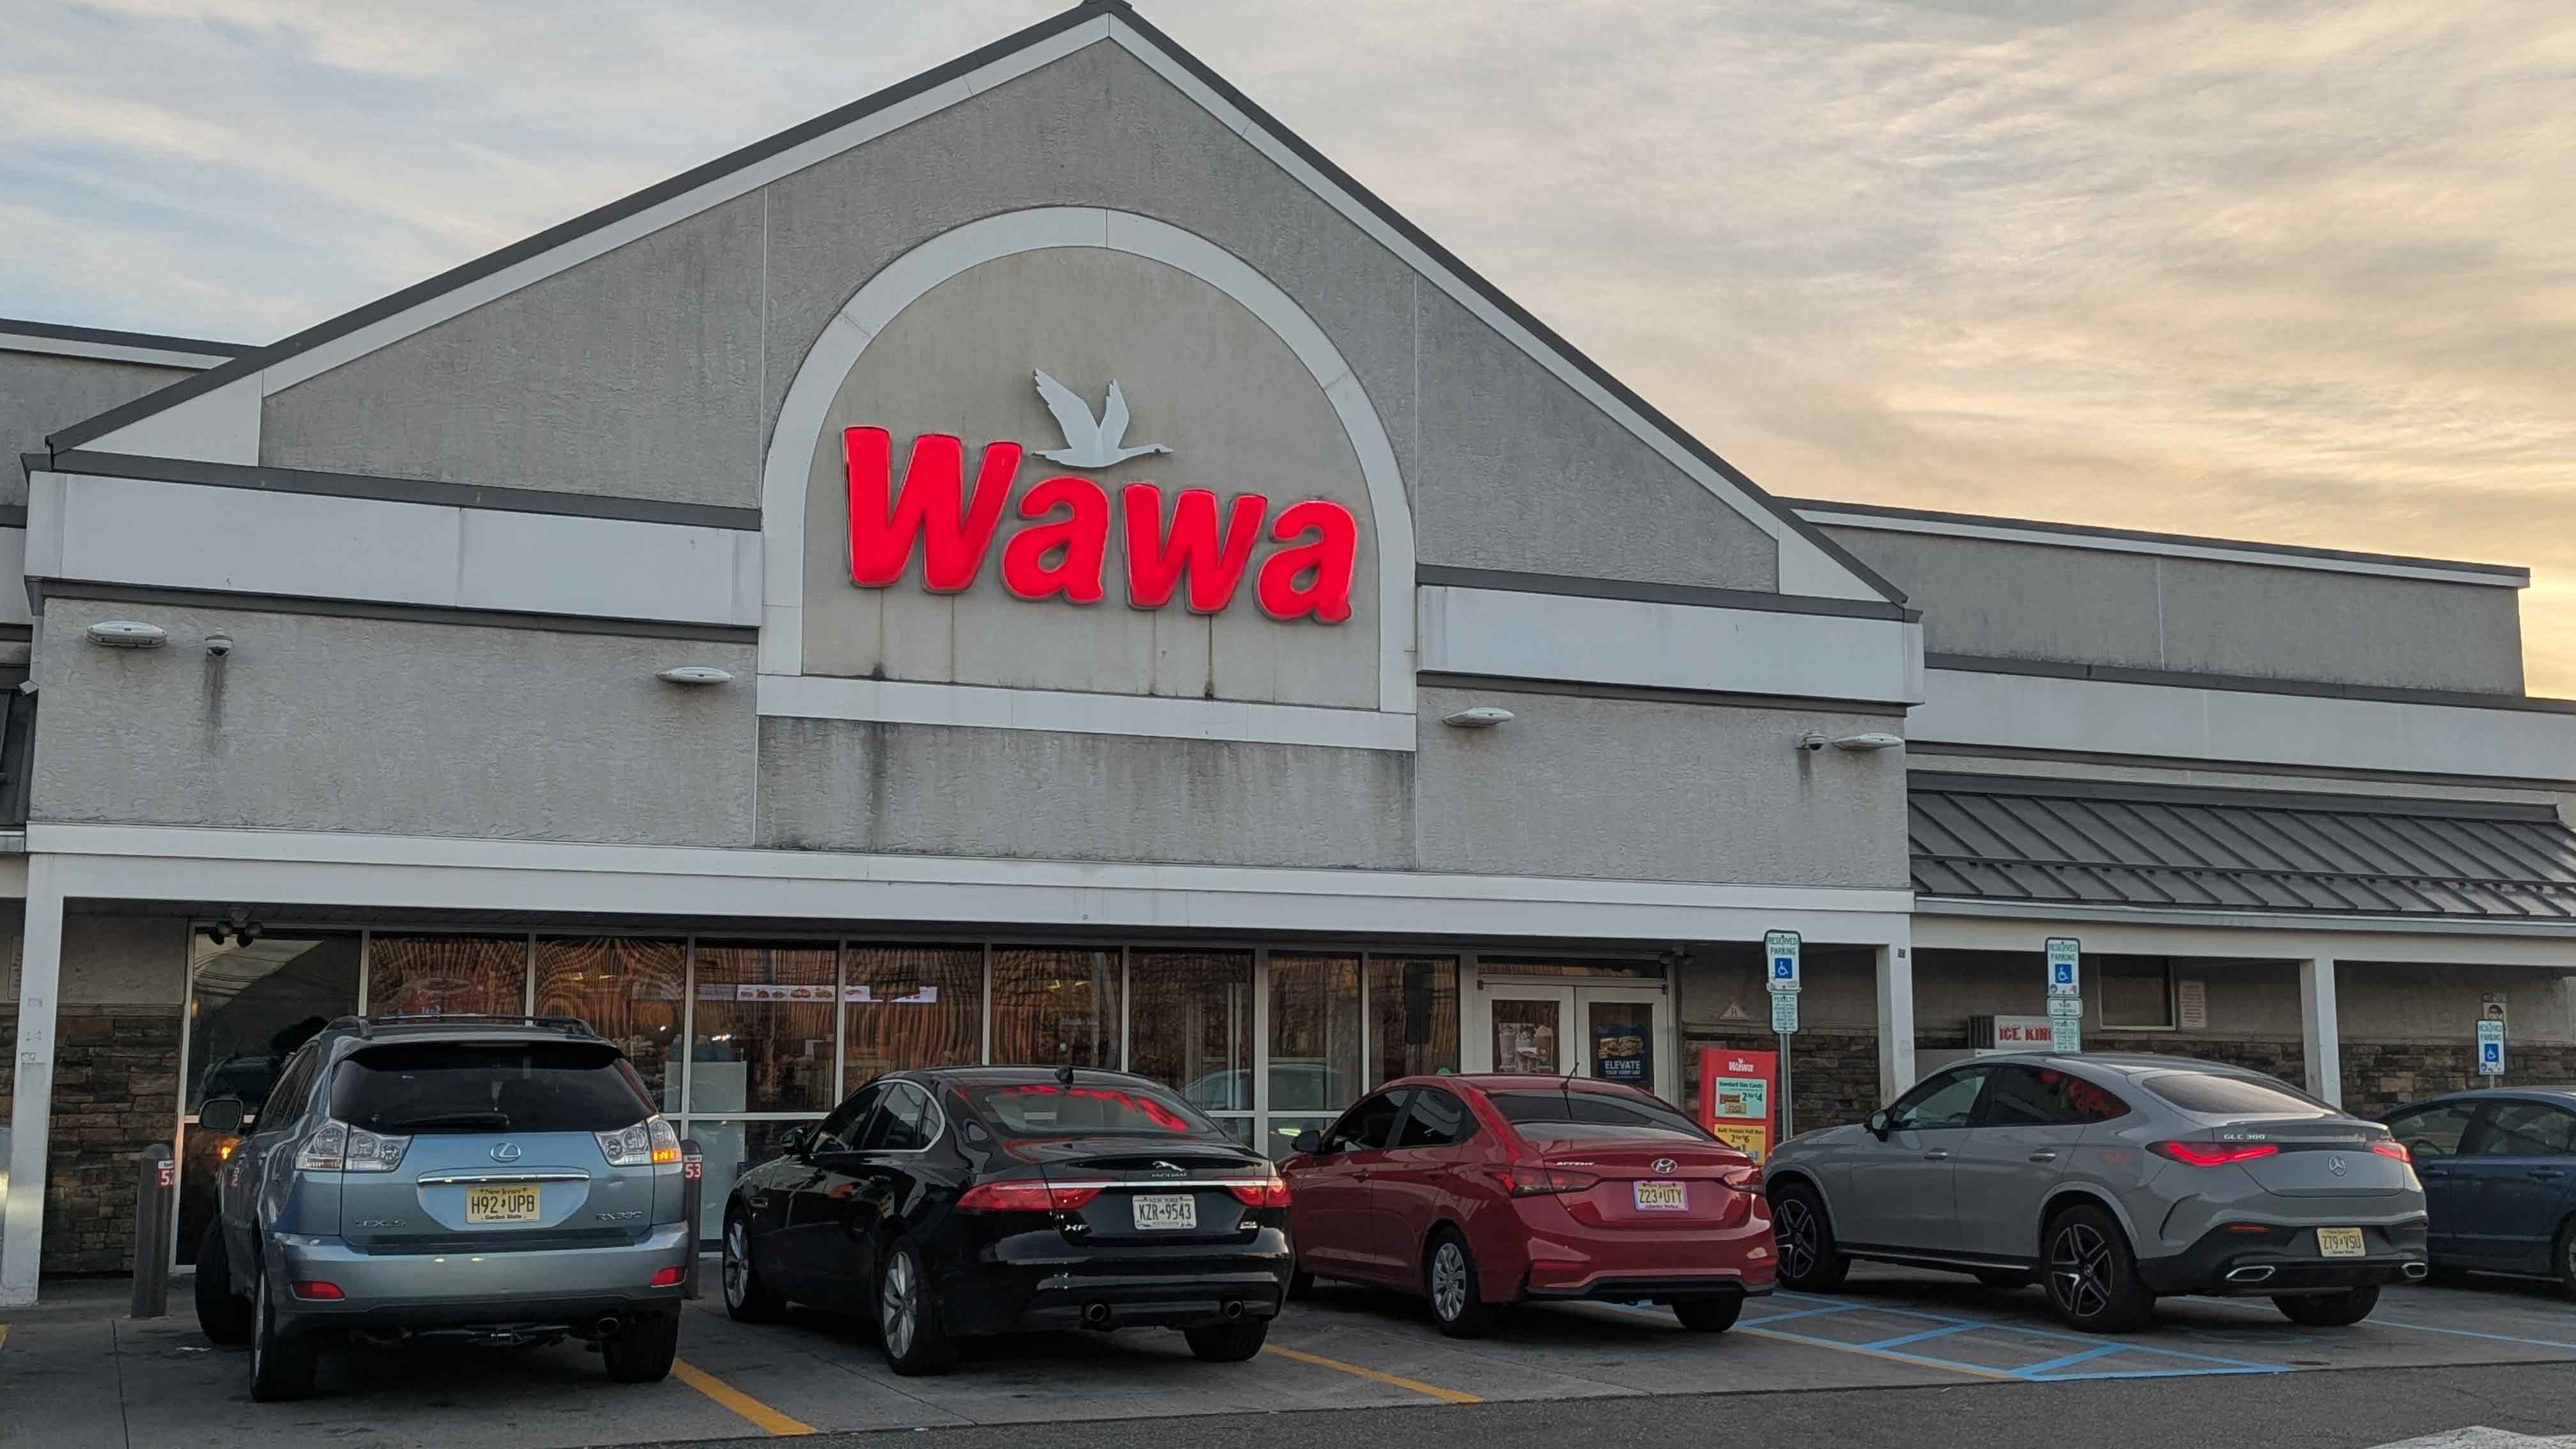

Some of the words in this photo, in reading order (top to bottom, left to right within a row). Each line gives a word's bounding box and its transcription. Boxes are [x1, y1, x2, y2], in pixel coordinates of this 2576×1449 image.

[844, 425, 1356, 624] Wawa
[1770, 947, 1796, 955] PARKING
[2050, 953, 2076, 962] PARKING
[1999, 1027, 2021, 1040] ICE
[2025, 1027, 2051, 1041] KIN
[1604, 1061, 1641, 1070] ELEVATE
[1728, 1061, 1754, 1072] Wawa
[1742, 1092, 1747, 1101] 2
[685, 1163, 701, 1178] 53
[1663, 1189, 1682, 1203] UTY
[471, 1195, 498, 1214] H92
[508, 1195, 535, 1213] UPB
[1139, 1204, 1159, 1220] KZR
[1165, 1204, 1192, 1220] 9543
